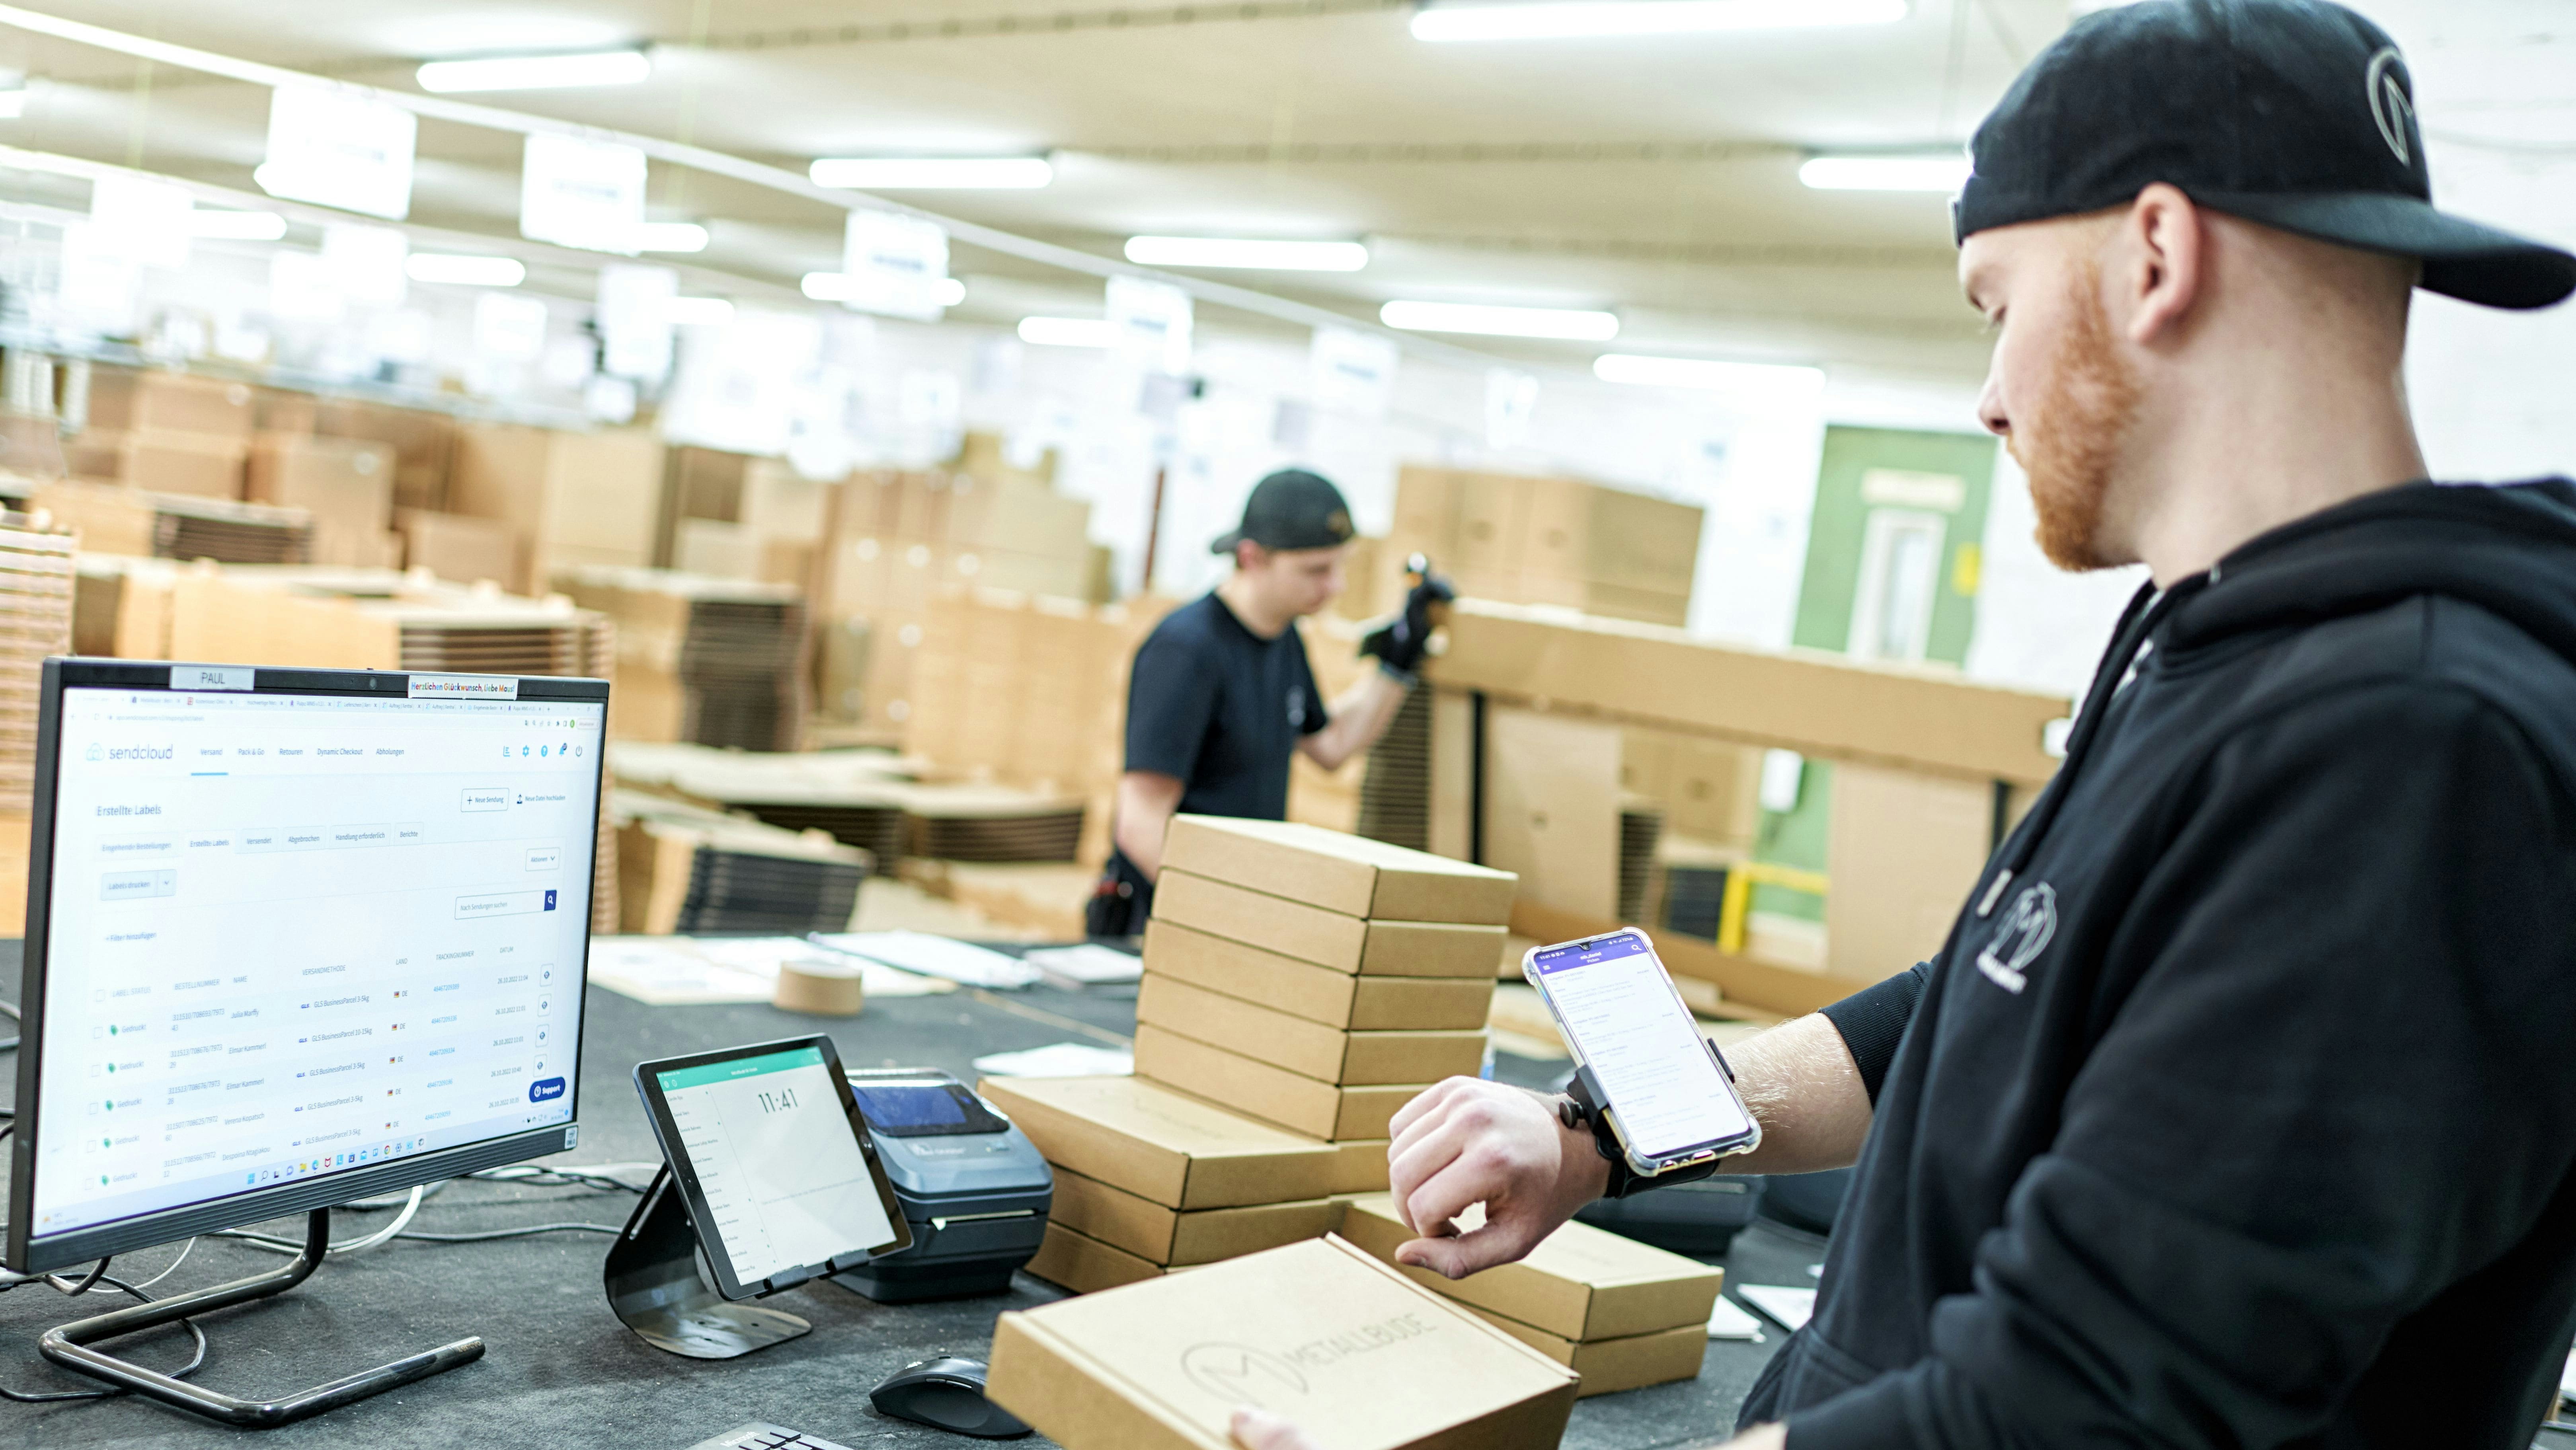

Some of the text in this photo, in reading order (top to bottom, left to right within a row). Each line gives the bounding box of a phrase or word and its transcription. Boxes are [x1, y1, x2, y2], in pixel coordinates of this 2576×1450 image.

[201, 672, 225, 684] PAUL
[444, 683, 483, 692] Glückwunsch,
[109, 744, 173, 760] sendcloud
[97, 805, 162, 816] Erstellte Labels
[288, 836, 320, 844] Abgebrochen
[102, 844, 135, 853] Eingehende
[436, 951, 474, 960] TRACKINGNUMMER
[1580, 951, 1602, 960] mb_daniel
[302, 965, 346, 975] VERSANDMETHODE
[174, 979, 220, 990] BESTELLNUMMER
[131, 987, 151, 995] STATUS
[324, 996, 356, 1007] BusinessParcel
[122, 1024, 146, 1033] Gedruckt
[322, 1030, 355, 1041] BusinessParcel
[229, 1043, 266, 1054] Elmar Kammerl
[119, 1061, 144, 1070] Gedruckt
[320, 1064, 352, 1075] BusinessParcel
[226, 1078, 264, 1090] Elmar Kammerl
[542, 1084, 560, 1095] Support
[117, 1098, 142, 1108] Gedruckt
[317, 1097, 350, 1108] BusinessParcel
[759, 1088, 798, 1114] 11:41
[242, 1113, 265, 1122] Kopatsch
[115, 1135, 140, 1145] Gedruckt
[315, 1131, 348, 1142] BusinessParcel
[222, 1152, 246, 1162] Despoina
[113, 1172, 137, 1182] Gedruckt
[1283, 1313, 1437, 1366] METALLBUDE
[720, 1431, 760, 1448] Microsoft
